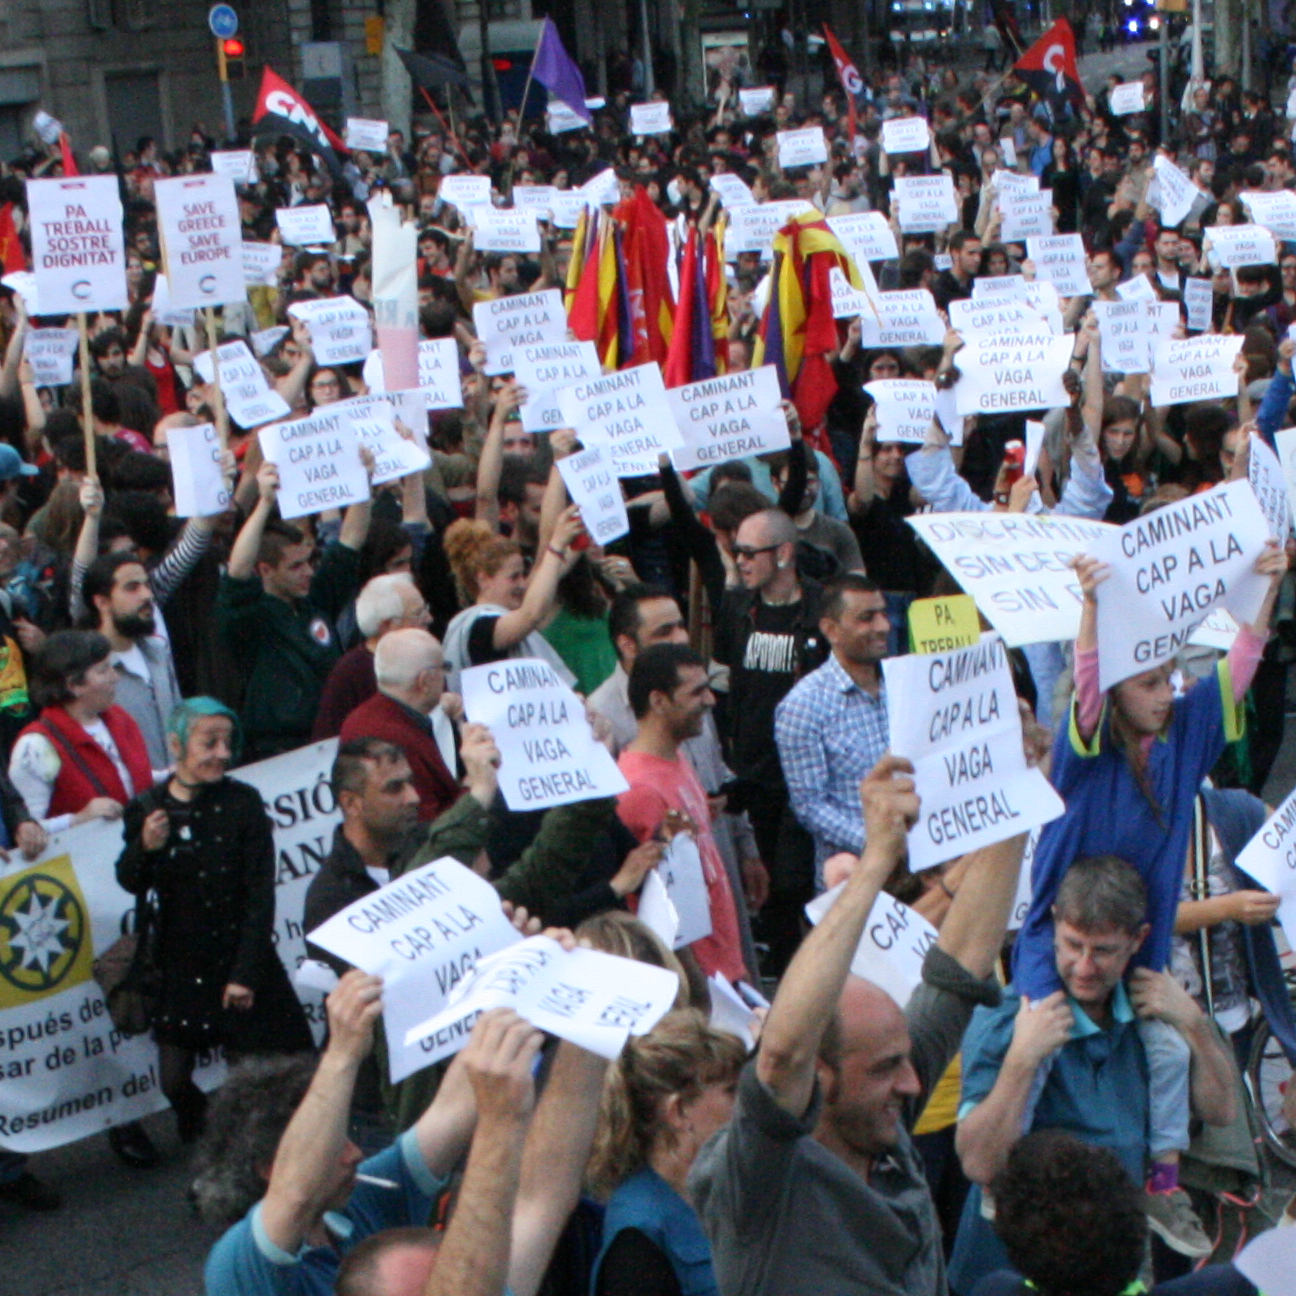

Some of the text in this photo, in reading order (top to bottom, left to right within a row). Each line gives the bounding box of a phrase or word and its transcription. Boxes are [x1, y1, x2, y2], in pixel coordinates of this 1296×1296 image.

[64, 204, 87, 219] PA
[182, 203, 216, 216] SAVE
[43, 219, 112, 235] TREBALL
[178, 215, 226, 232] GREECE
[48, 235, 109, 251] SOSTRE
[188, 233, 223, 248] SAVE
[43, 250, 115, 268] DIGNITAT
[181, 246, 232, 263] EUROPE
[977, 335, 1053, 349] CAMINANT
[979, 349, 1045, 366] CAP A LA
[680, 373, 755, 401] CAMINANT
[994, 368, 1034, 385] VAGA
[689, 395, 755, 422] CAP A LA
[979, 389, 1046, 408] GENERAL
[708, 417, 750, 438] VAGA
[697, 438, 766, 462] GENERAL
[1121, 494, 1232, 560] CAMINANT
[1135, 533, 1243, 595] CAP A LA
[1160, 580, 1226, 621] VAGA
[929, 638, 1007, 691] CAMINANT
[507, 702, 568, 728] CAP A LA
[929, 688, 1000, 743] CAP A LA
[524, 739, 570, 761] VAGA
[944, 744, 992, 786] VAGA
[518, 774, 597, 801] GENERAL
[928, 790, 1019, 845] GENERAL
[347, 871, 452, 934] CAMINANT
[391, 905, 484, 962] CAP A LA
[79, 998, 103, 1021] de
[45, 1042, 74, 1066] de
[82, 1034, 104, 1058] la
[122, 1067, 157, 1097] del
